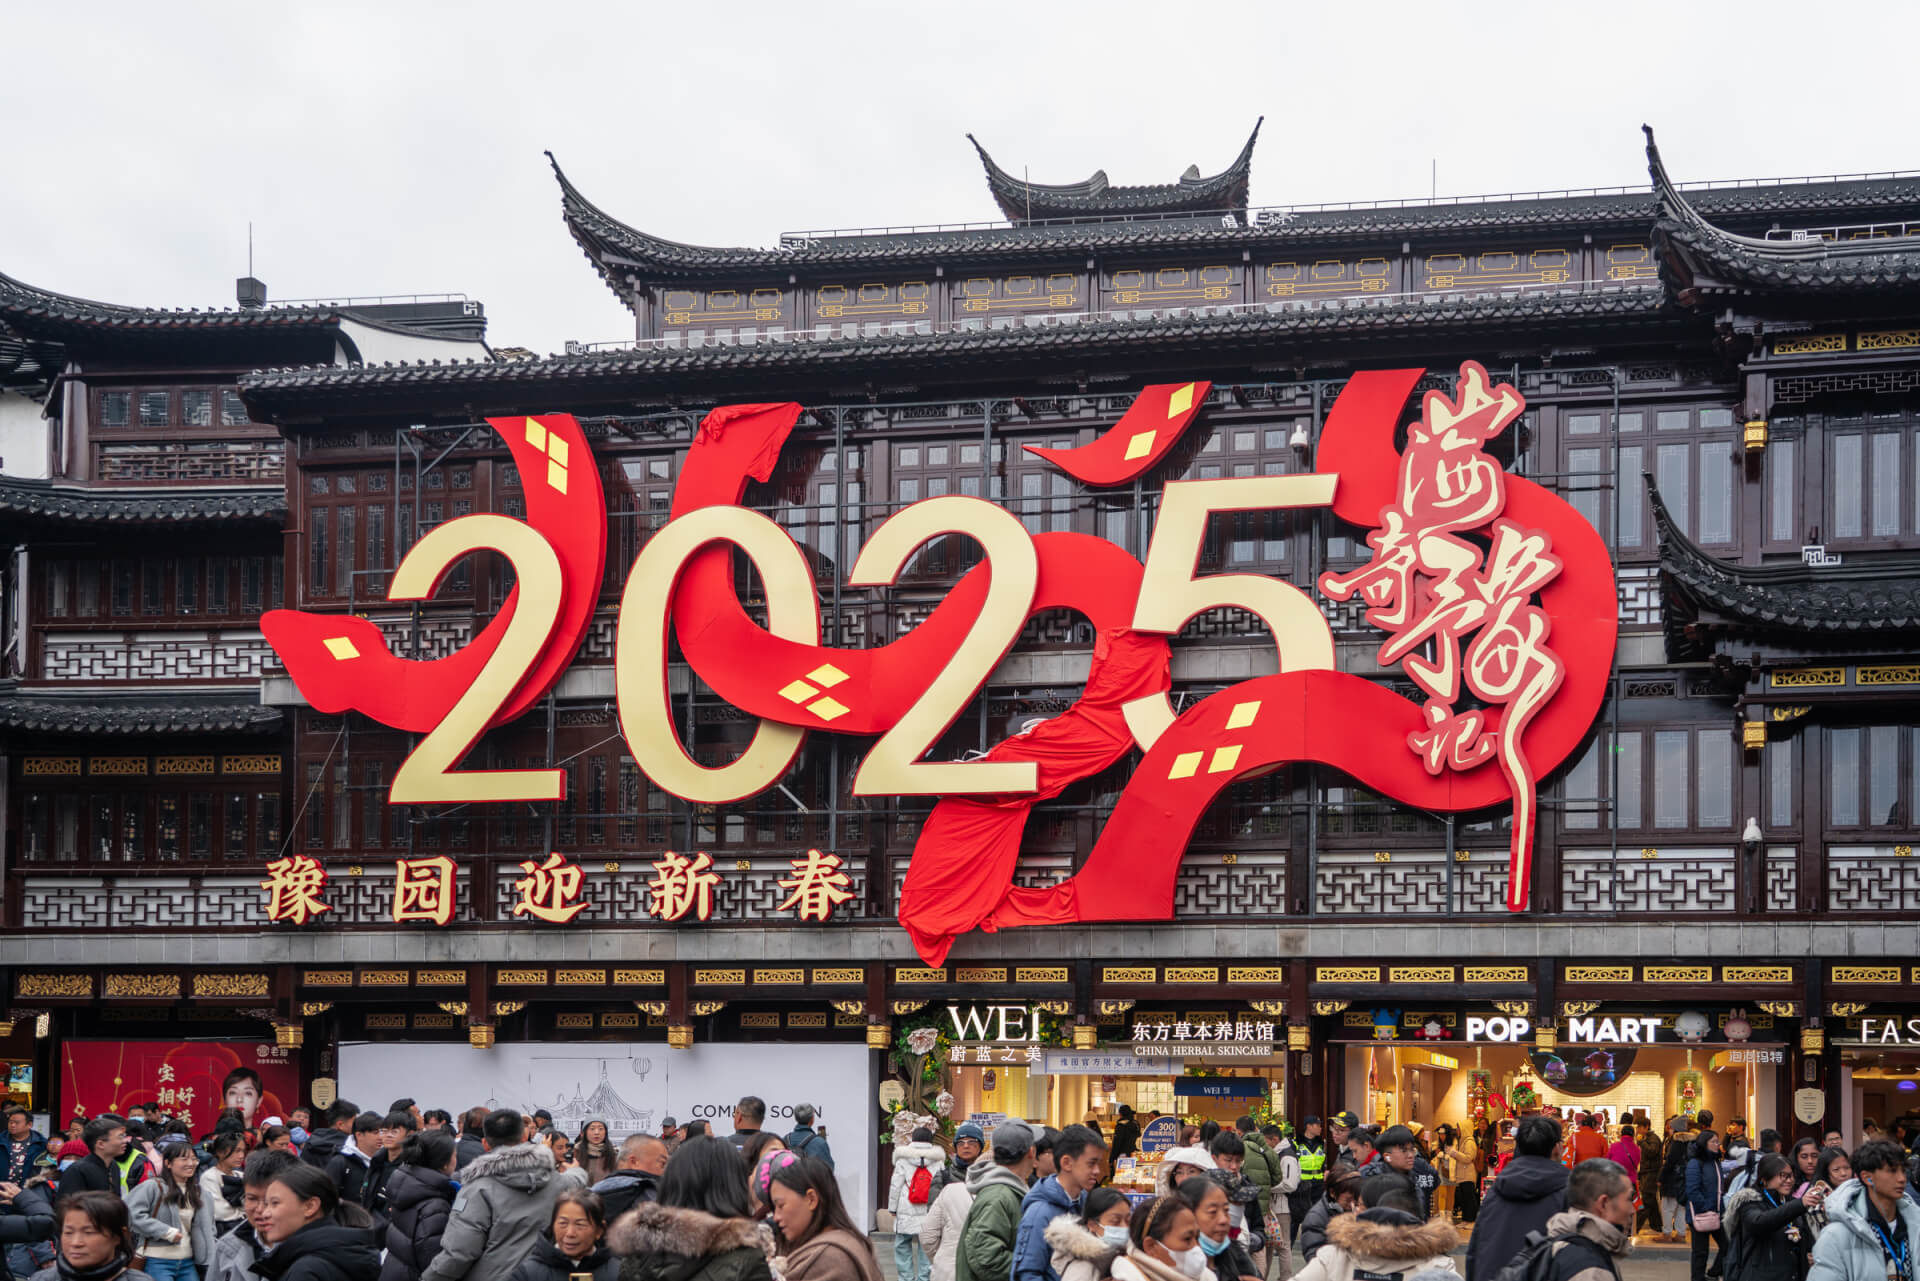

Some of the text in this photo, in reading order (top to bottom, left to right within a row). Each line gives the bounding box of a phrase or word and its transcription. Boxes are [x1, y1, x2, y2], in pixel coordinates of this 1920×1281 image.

[386, 472, 1338, 804] 2025
[260, 848, 856, 926] 豫园迎新春
[946, 1005, 1041, 1041] WEI
[1132, 1021, 1275, 1041] 东方草本养肤馆
[1466, 1017, 1662, 1043] POP MART
[1862, 1019, 1920, 1044] FAS
[950, 1045, 1041, 1062] 蔚蓝之美
[1135, 1045, 1271, 1056] CHINA HERBAL SKINCARE
[1729, 1051, 1784, 1064] 泡泡玛特
[770, 1104, 822, 1118] SON
